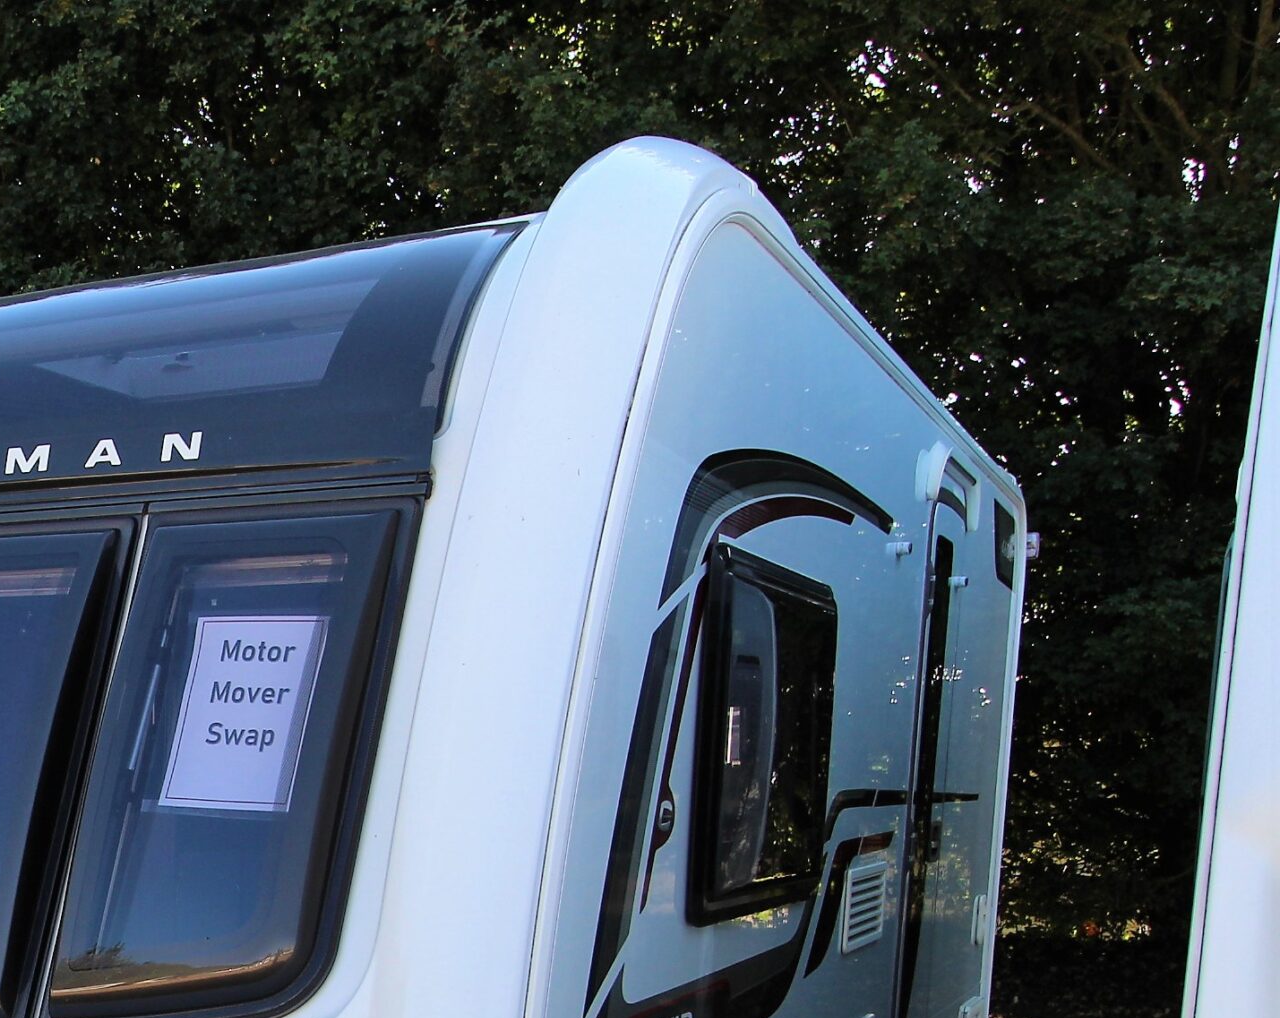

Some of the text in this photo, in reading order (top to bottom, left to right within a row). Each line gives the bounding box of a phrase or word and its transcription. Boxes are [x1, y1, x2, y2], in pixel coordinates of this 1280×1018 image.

[220, 639, 297, 664] Motor
[210, 680, 291, 705] Mover
[205, 722, 276, 753] Swap
